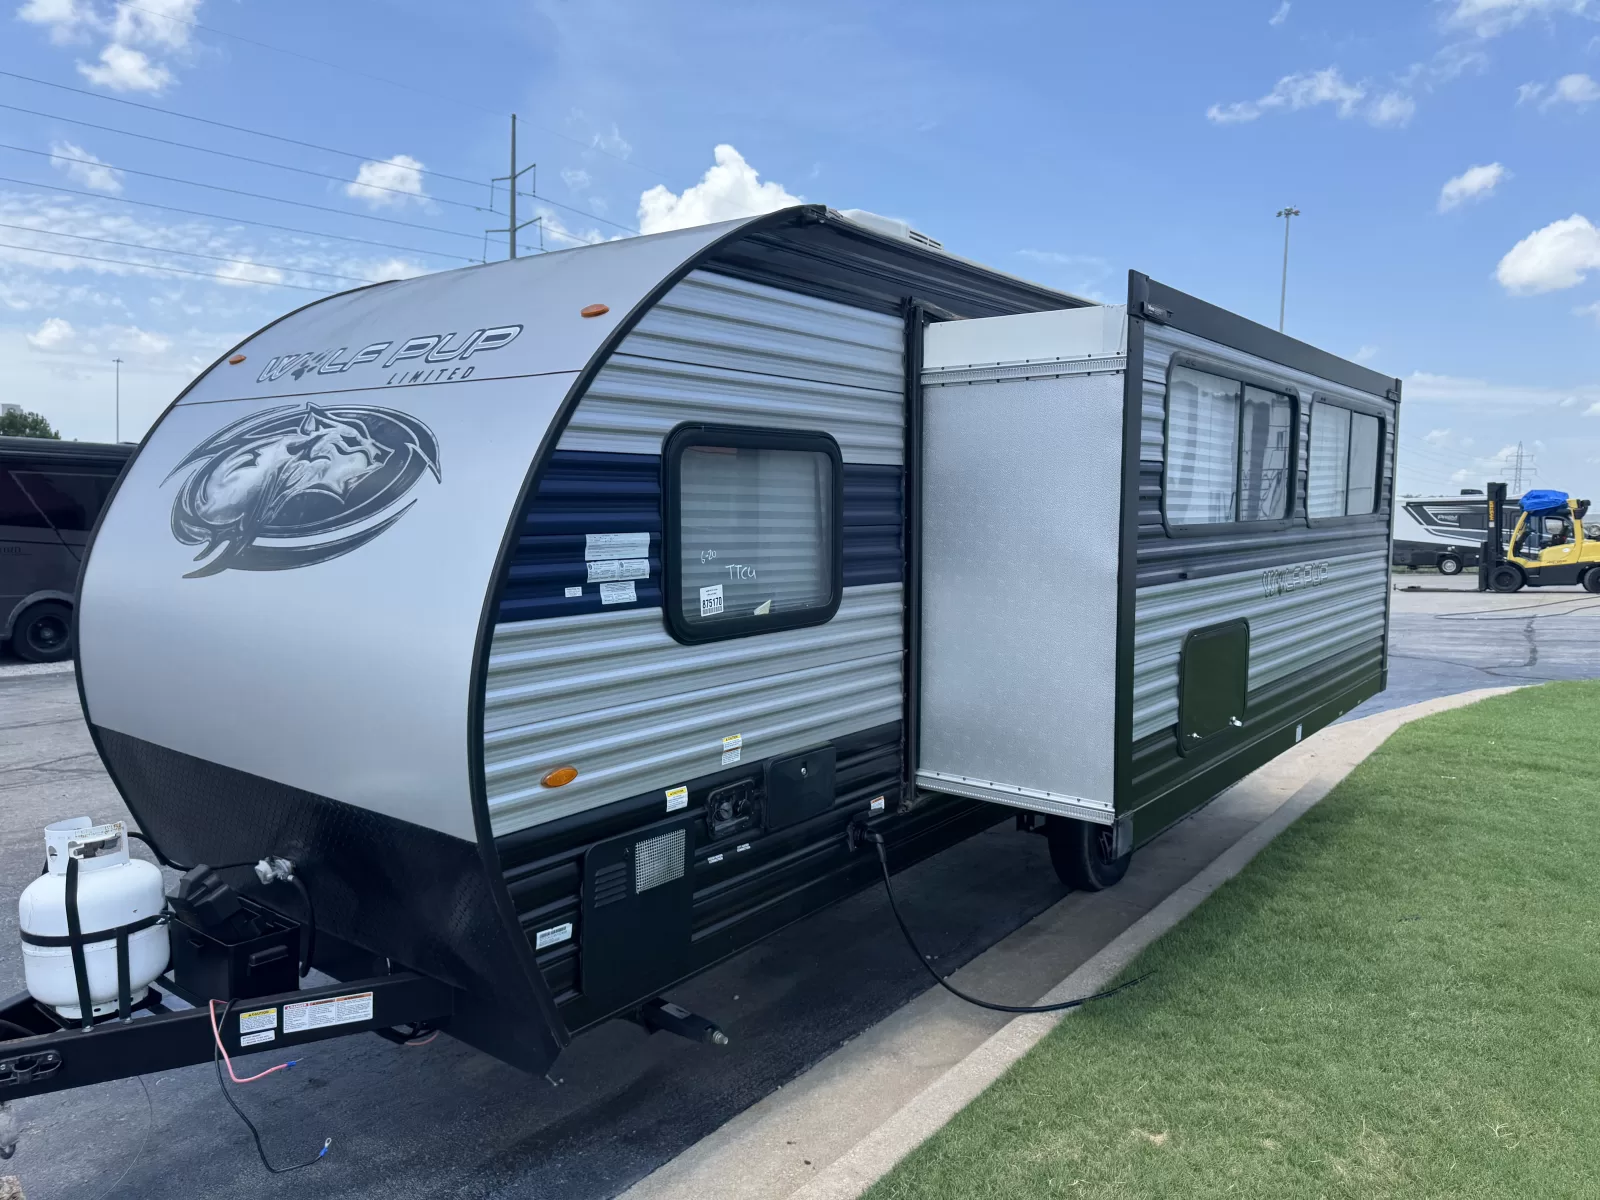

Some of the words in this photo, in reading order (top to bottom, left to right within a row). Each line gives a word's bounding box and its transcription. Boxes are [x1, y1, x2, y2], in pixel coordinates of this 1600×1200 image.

[381, 324, 524, 369] PUP
[386, 366, 476, 386] LIMITED
[725, 564, 757, 580] TTCU
[1303, 561, 1329, 589] PUP
[702, 596, 723, 609] 875170
